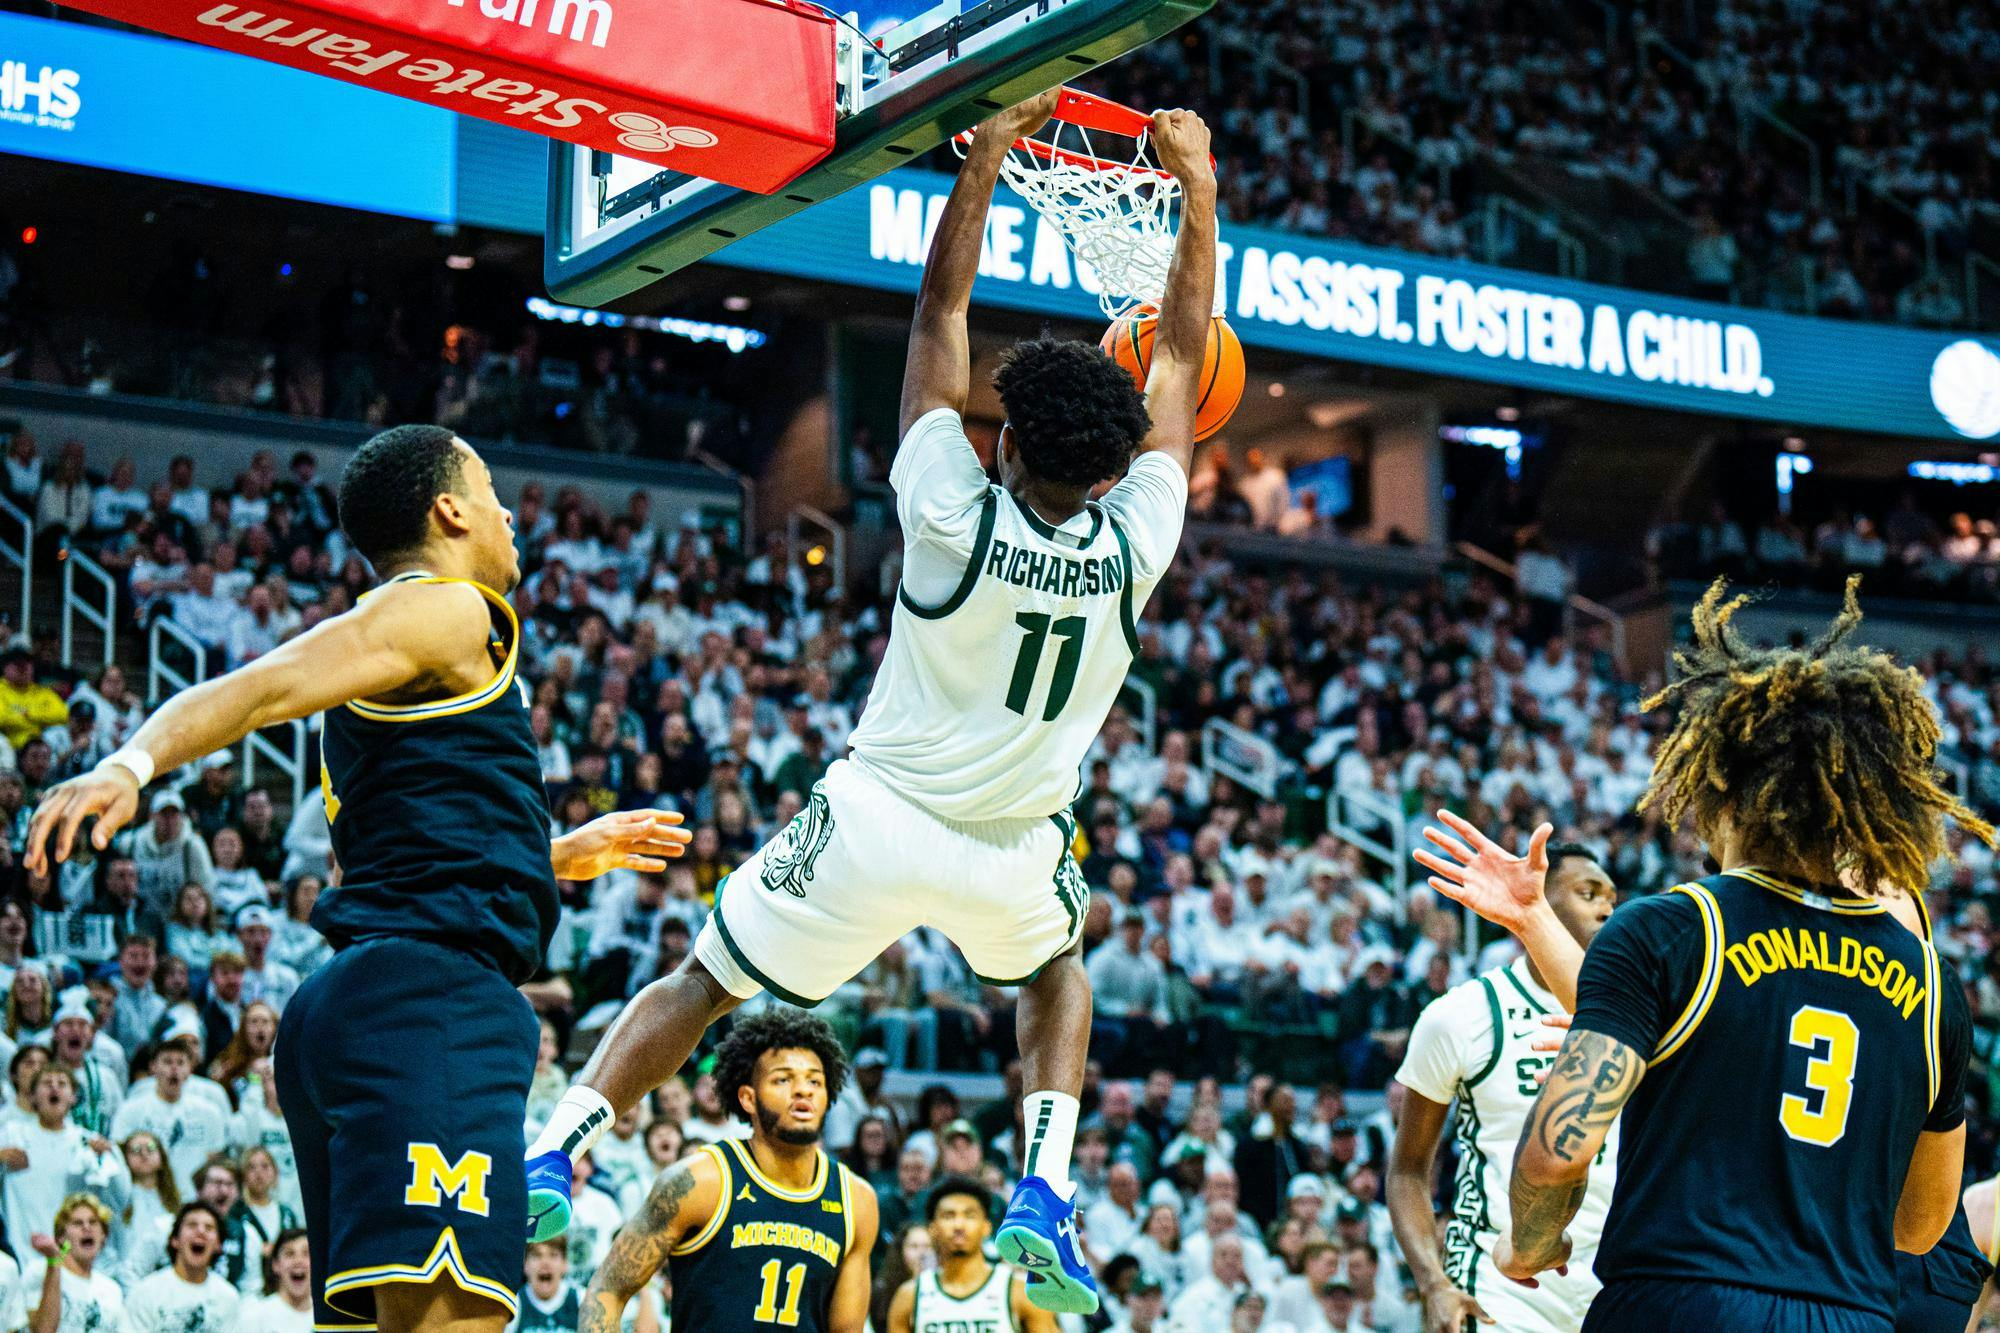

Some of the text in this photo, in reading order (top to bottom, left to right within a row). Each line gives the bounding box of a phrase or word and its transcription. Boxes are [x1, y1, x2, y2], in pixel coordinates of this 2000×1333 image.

[447, 0, 613, 48] arm
[1029, 212, 1071, 289] A
[1236, 246, 1413, 344] ASSIST.
[1416, 274, 1586, 370] FOSTER
[1589, 304, 1625, 376] A
[1627, 309, 1775, 397] CHILD.
[1005, 611, 1087, 722] 11
[1725, 927, 1926, 1021] DONALDSON
[1779, 1005, 1860, 1148] 3
[404, 1142, 492, 1218] M
[731, 1221, 841, 1268] MICHIGAN
[753, 1258, 808, 1327] 11
